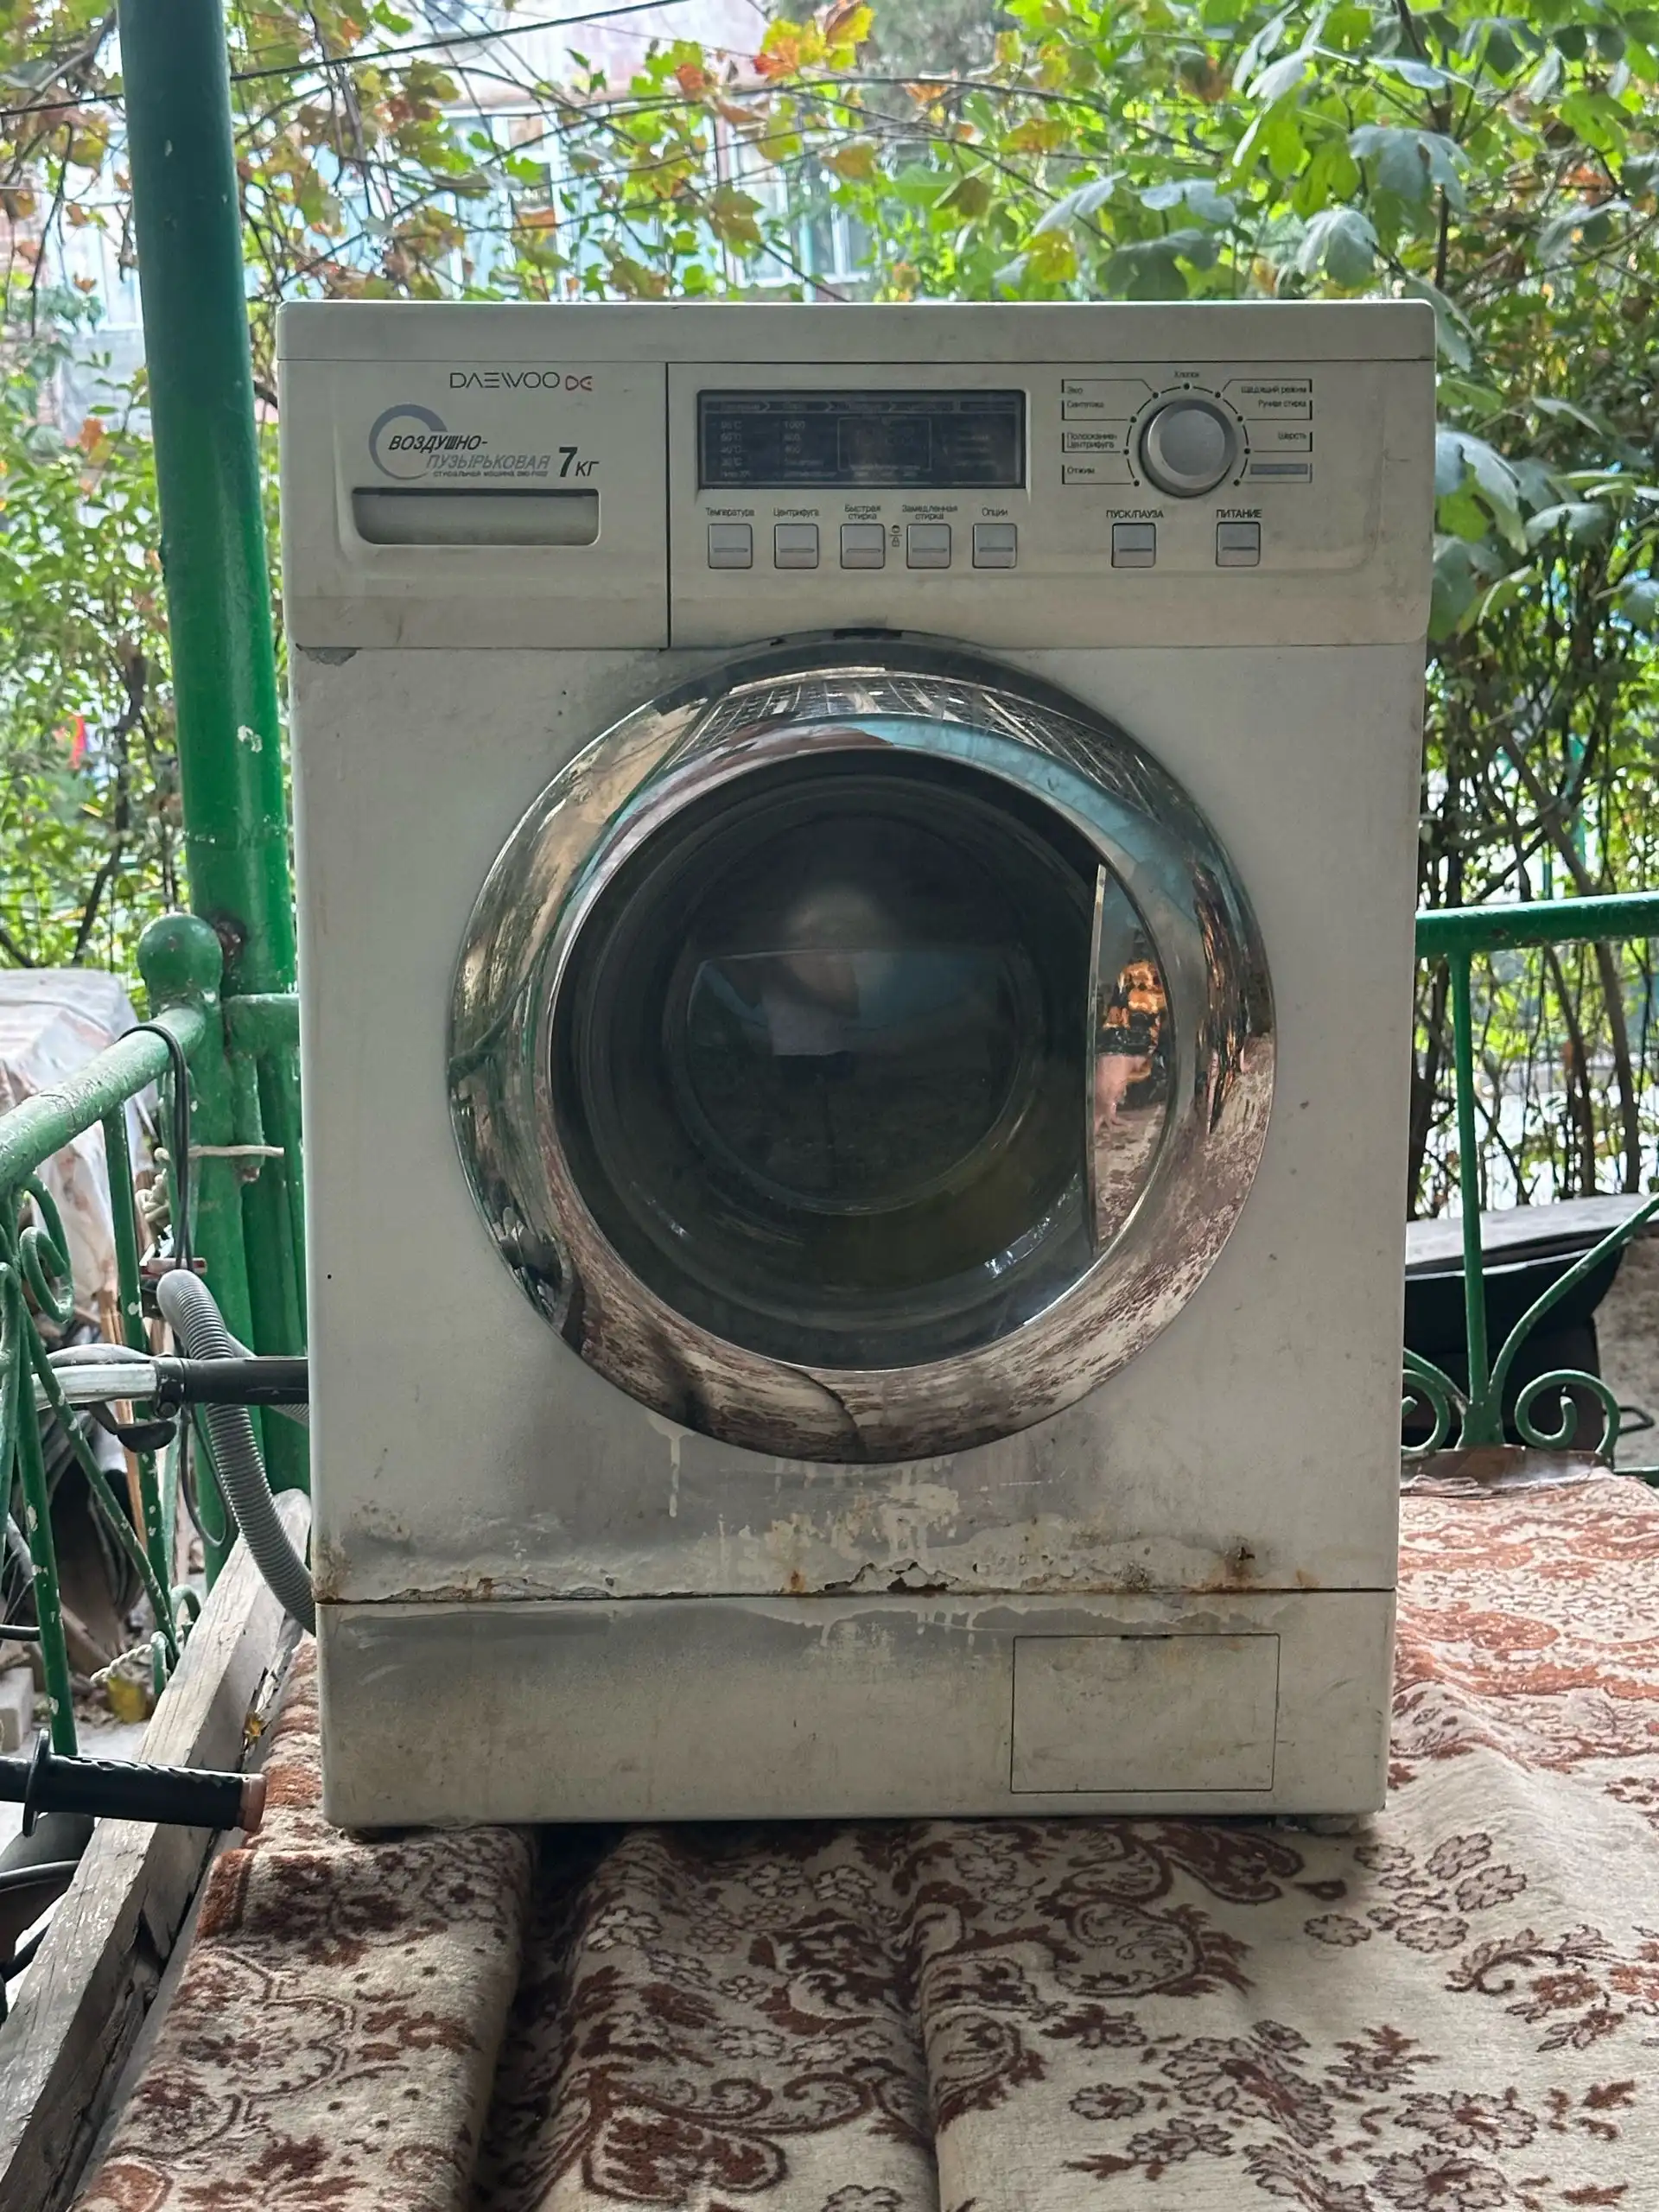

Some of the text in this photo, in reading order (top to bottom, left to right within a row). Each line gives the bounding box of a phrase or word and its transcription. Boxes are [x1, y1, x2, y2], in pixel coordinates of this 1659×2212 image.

[449, 372, 561, 389] DAEWOO
[388, 435, 488, 454] ВОЗДУШНО-
[426, 454, 550, 470] ПУЗЫРЬКОВАЯ
[558, 446, 579, 478] 7
[705, 507, 756, 518] Температура
[772, 507, 820, 518] Центрифуга
[982, 507, 1009, 518] Опции
[1105, 509, 1165, 519] ПУСК/ПАУЗА
[1216, 509, 1263, 519] ПИТАНИЕ
